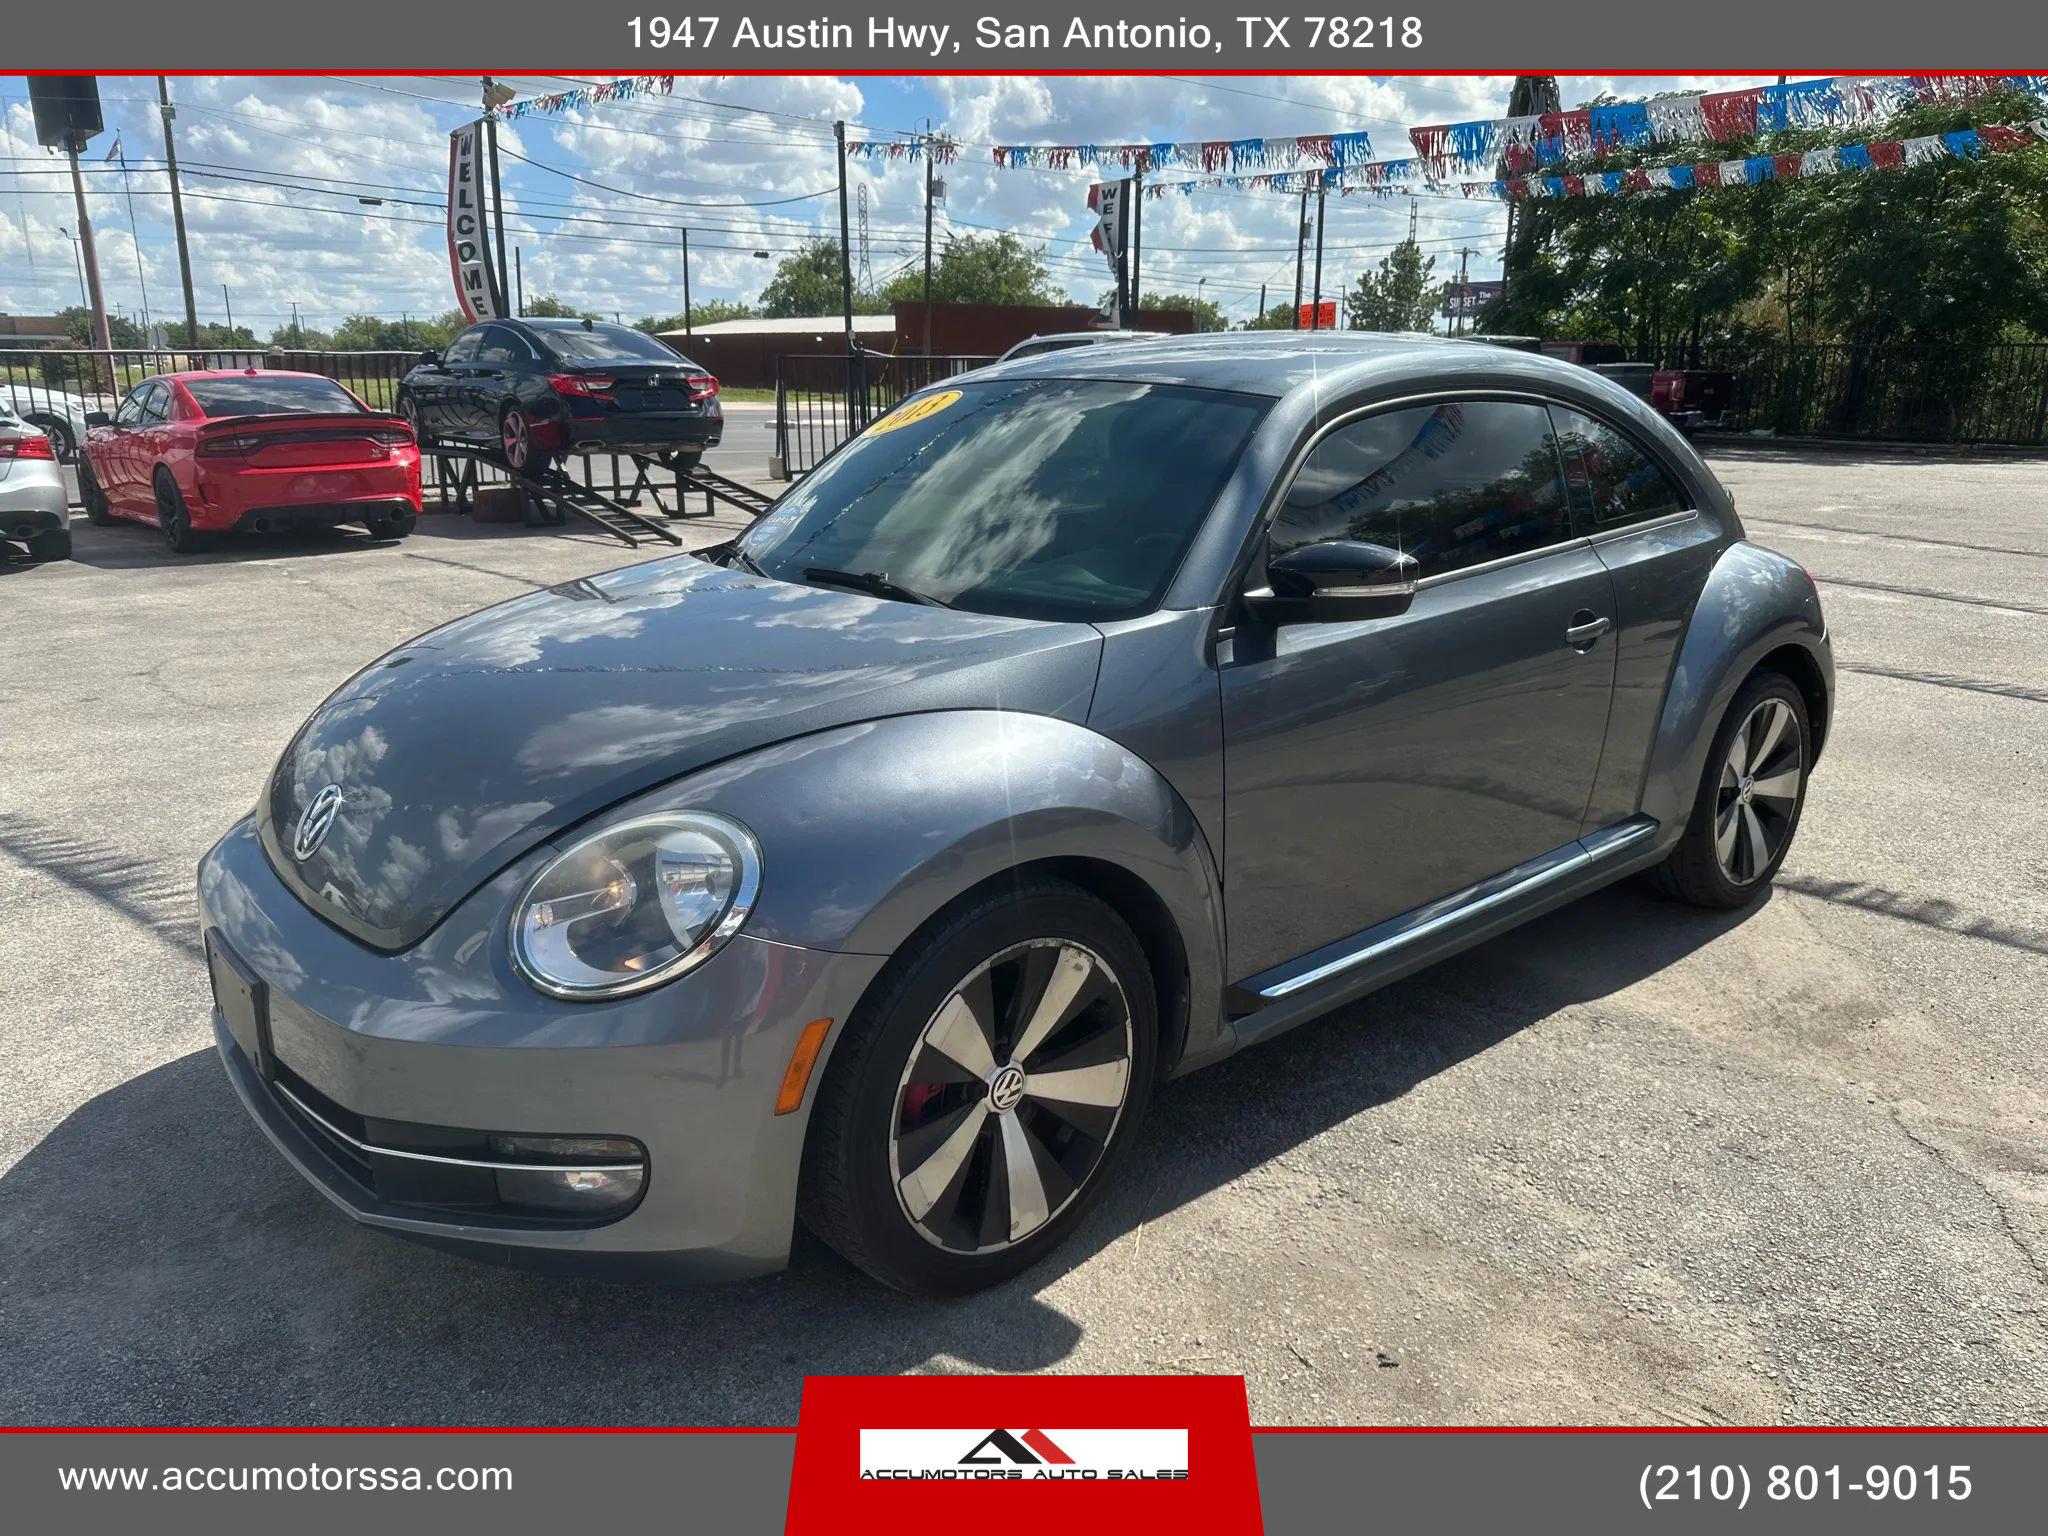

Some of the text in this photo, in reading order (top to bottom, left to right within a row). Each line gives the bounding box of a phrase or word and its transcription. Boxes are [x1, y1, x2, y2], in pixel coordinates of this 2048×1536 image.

[456, 133, 488, 316] WELCOME
[1449, 296, 1477, 309] SUSET
[871, 394, 950, 432] 2013
